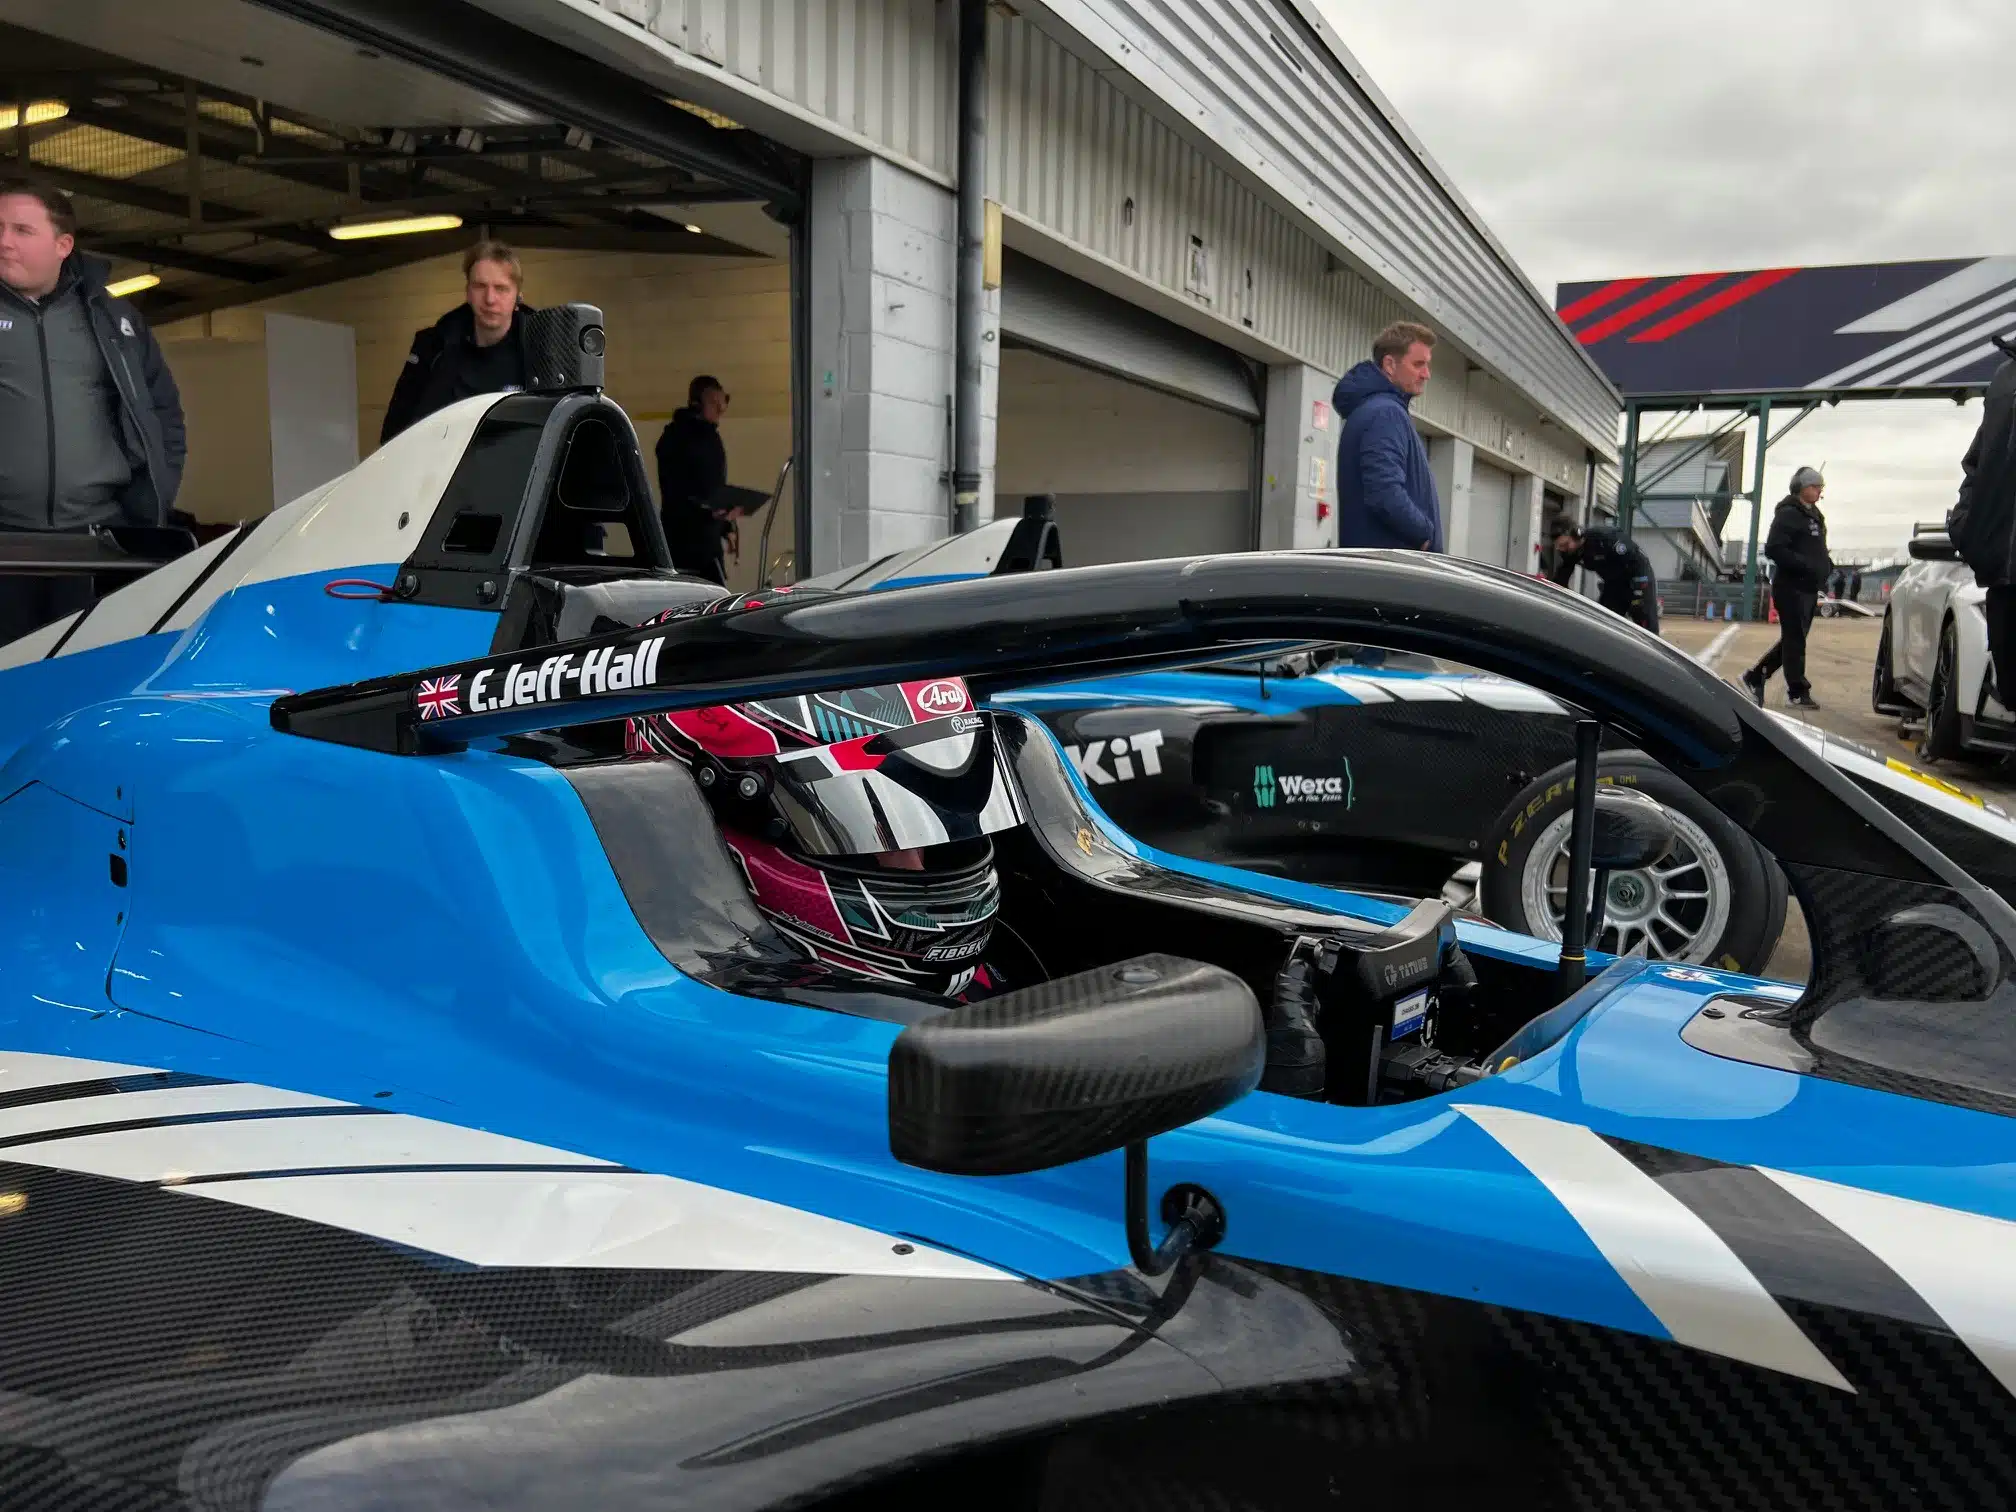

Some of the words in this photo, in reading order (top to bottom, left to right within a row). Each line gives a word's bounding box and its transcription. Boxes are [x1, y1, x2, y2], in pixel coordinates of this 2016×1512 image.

[469, 637, 665, 713] E.Jeff-Hall
[923, 685, 963, 708] Arai
[964, 716, 983, 726] RACING
[1063, 729, 1164, 787] KiT
[1279, 775, 1342, 795] Wera
